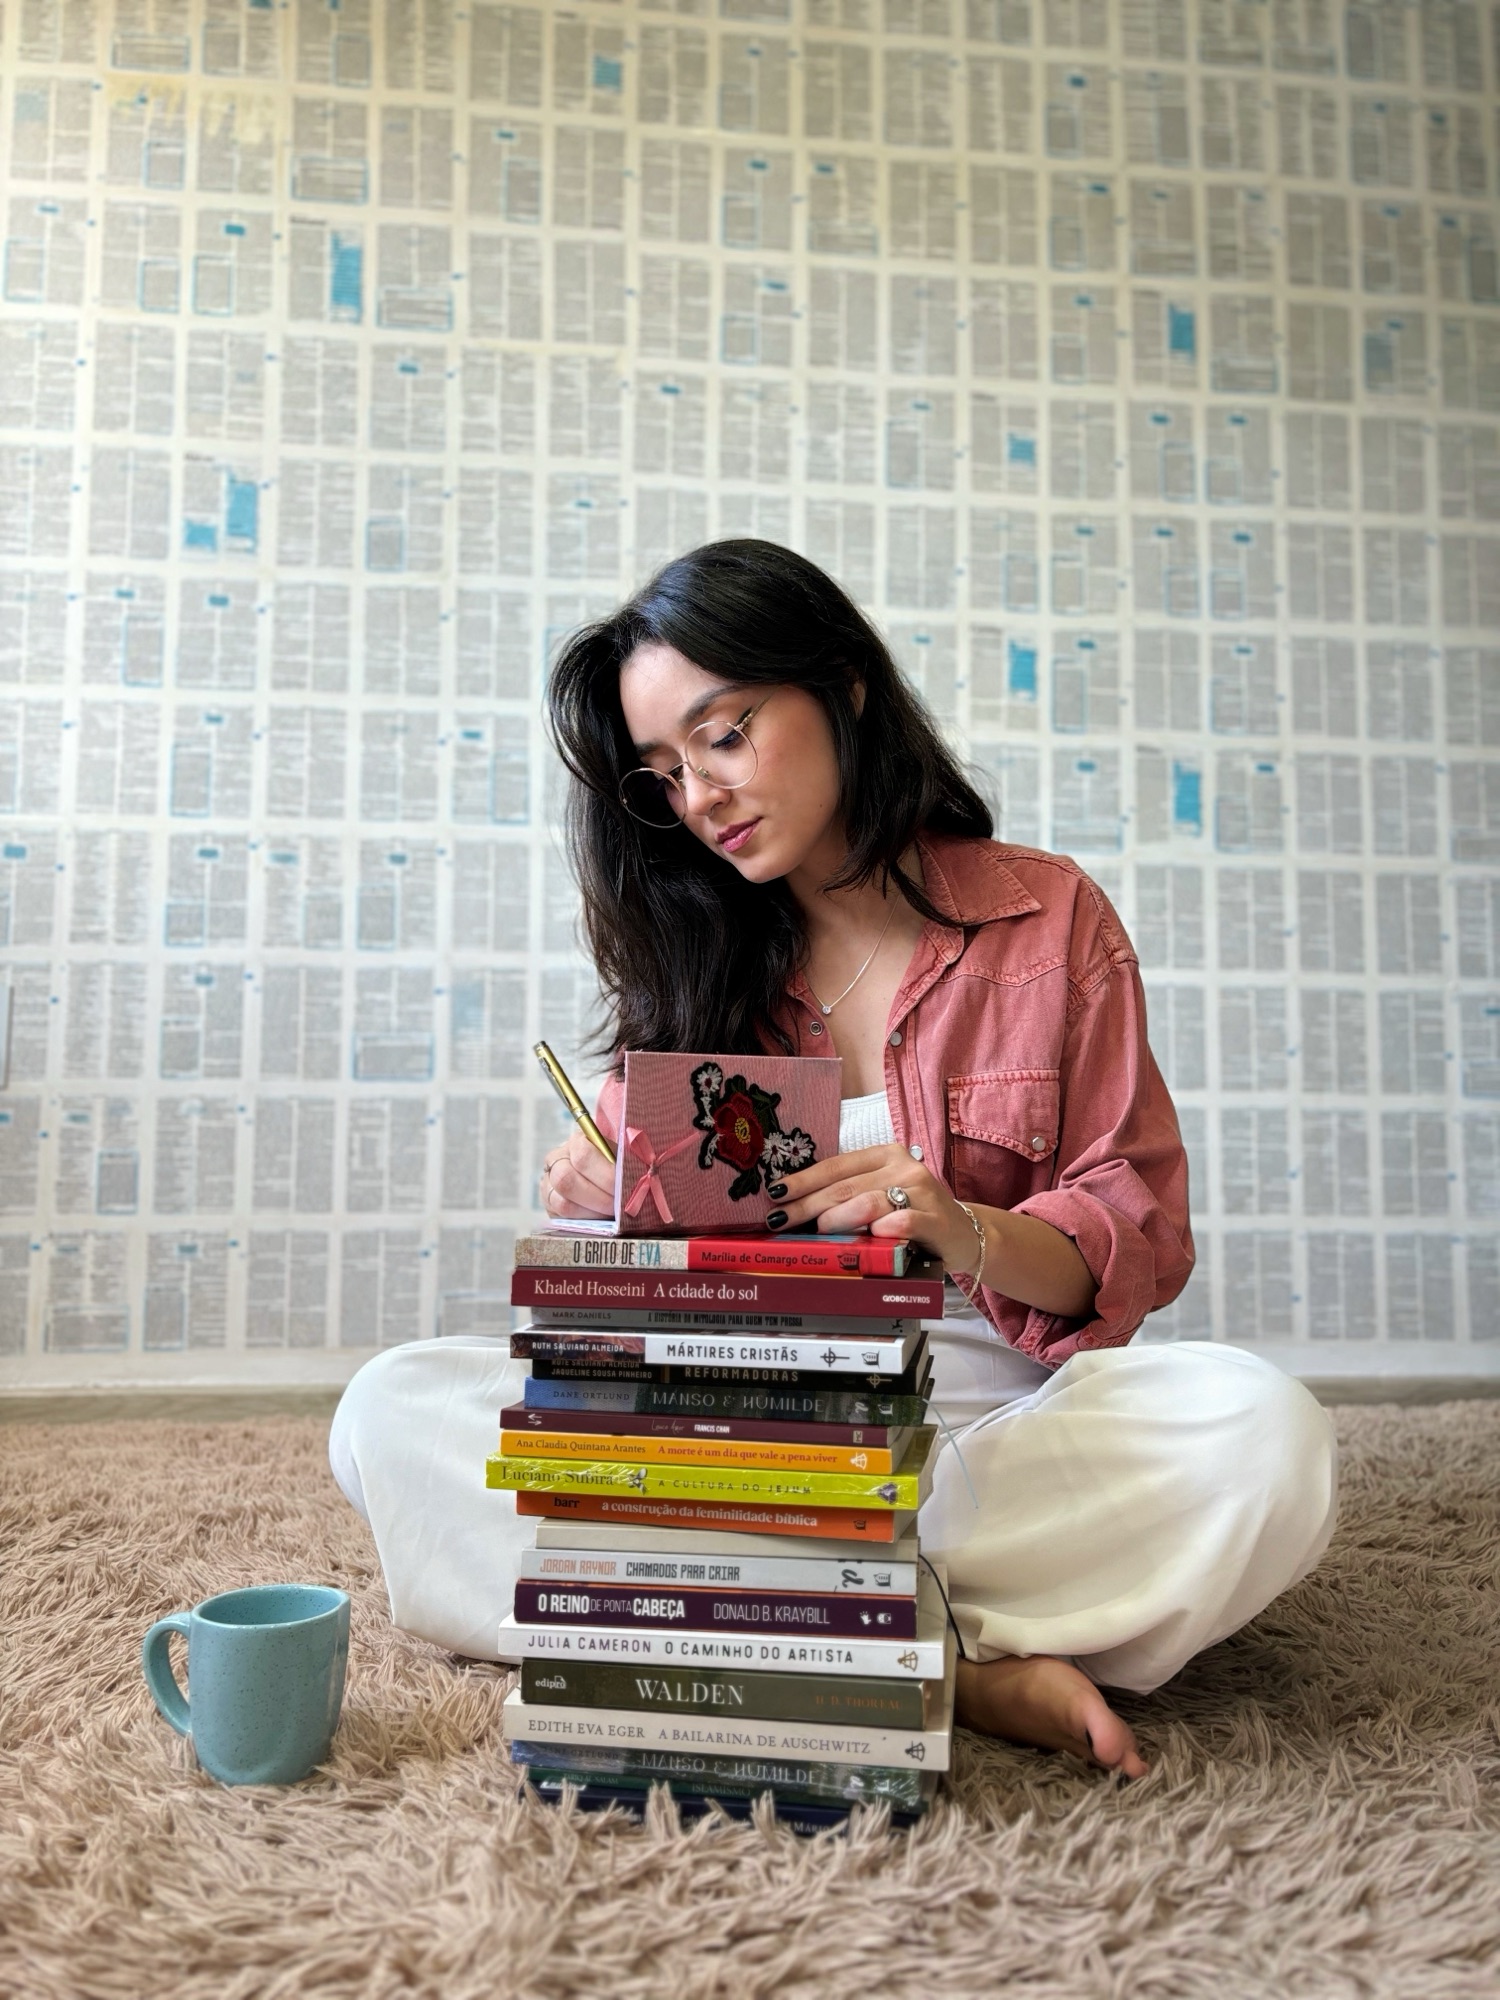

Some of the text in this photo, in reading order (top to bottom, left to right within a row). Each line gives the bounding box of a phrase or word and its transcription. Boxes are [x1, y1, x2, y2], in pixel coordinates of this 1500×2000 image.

[573, 1240, 661, 1266] O GRITO DE EVA
[701, 1251, 828, 1267] Marília de Camargo César
[534, 1279, 645, 1297] Khaled Hosseini
[653, 1283, 758, 1300] A cidade do sol
[648, 1311, 652, 1322] A
[654, 1310, 682, 1323] HISTÓRIA
[694, 1313, 726, 1324] MITOLOGIA
[728, 1314, 743, 1325] PARA
[745, 1315, 763, 1326] QUEM
[765, 1316, 778, 1326] TEM
[780, 1316, 803, 1327] PRESSA
[553, 1342, 590, 1351] SALVIANO
[591, 1343, 624, 1352] ALMEIDA
[667, 1341, 798, 1362] MÁRTIRES CRISTÃS
[551, 1368, 652, 1379] JAQUELINE SOUSA PINHEIRO
[685, 1366, 799, 1382] REFORMADORAS
[553, 1391, 630, 1400] DANE ORTLUND
[653, 1391, 715, 1407] MANSO
[743, 1395, 824, 1413] HUMILDE
[694, 1424, 730, 1434] FRANCIS CHAN
[516, 1439, 646, 1453] Ana Claudia Quintana Arantes
[658, 1446, 666, 1455] A
[667, 1447, 695, 1456] morte
[697, 1447, 703, 1456] é
[723, 1448, 738, 1458] dia
[740, 1452, 757, 1461] que
[759, 1451, 777, 1460] vale
[787, 1454, 810, 1463] pena
[812, 1454, 838, 1463] viver
[502, 1465, 614, 1486] Luciano Subirá
[658, 1479, 811, 1495] A CULTURA DO JEJUM
[554, 1496, 580, 1508] barr
[602, 1502, 817, 1527] a construção da feminilidade bíblica
[540, 1558, 617, 1576] JORDAN RAYNOR
[626, 1561, 740, 1581] CHAMADOS PARA CRIAR
[538, 1593, 685, 1620] O REINO DE PONTA CABEÇA
[714, 1603, 830, 1624] DONALD B. KRAYBILL
[528, 1635, 651, 1653] JULIA CAMERON
[665, 1641, 853, 1664] O CAMINHO DO ARTISTA
[635, 1678, 744, 1706] WALDEN
[528, 1719, 645, 1738] EDITH EVA EGER
[658, 1728, 871, 1754] A BAILARINA DE AUSCHWITZ
[642, 1752, 705, 1772] MANSO
[734, 1762, 816, 1784] HUMILDE
[692, 1783, 751, 1796] ISLAMISMO
